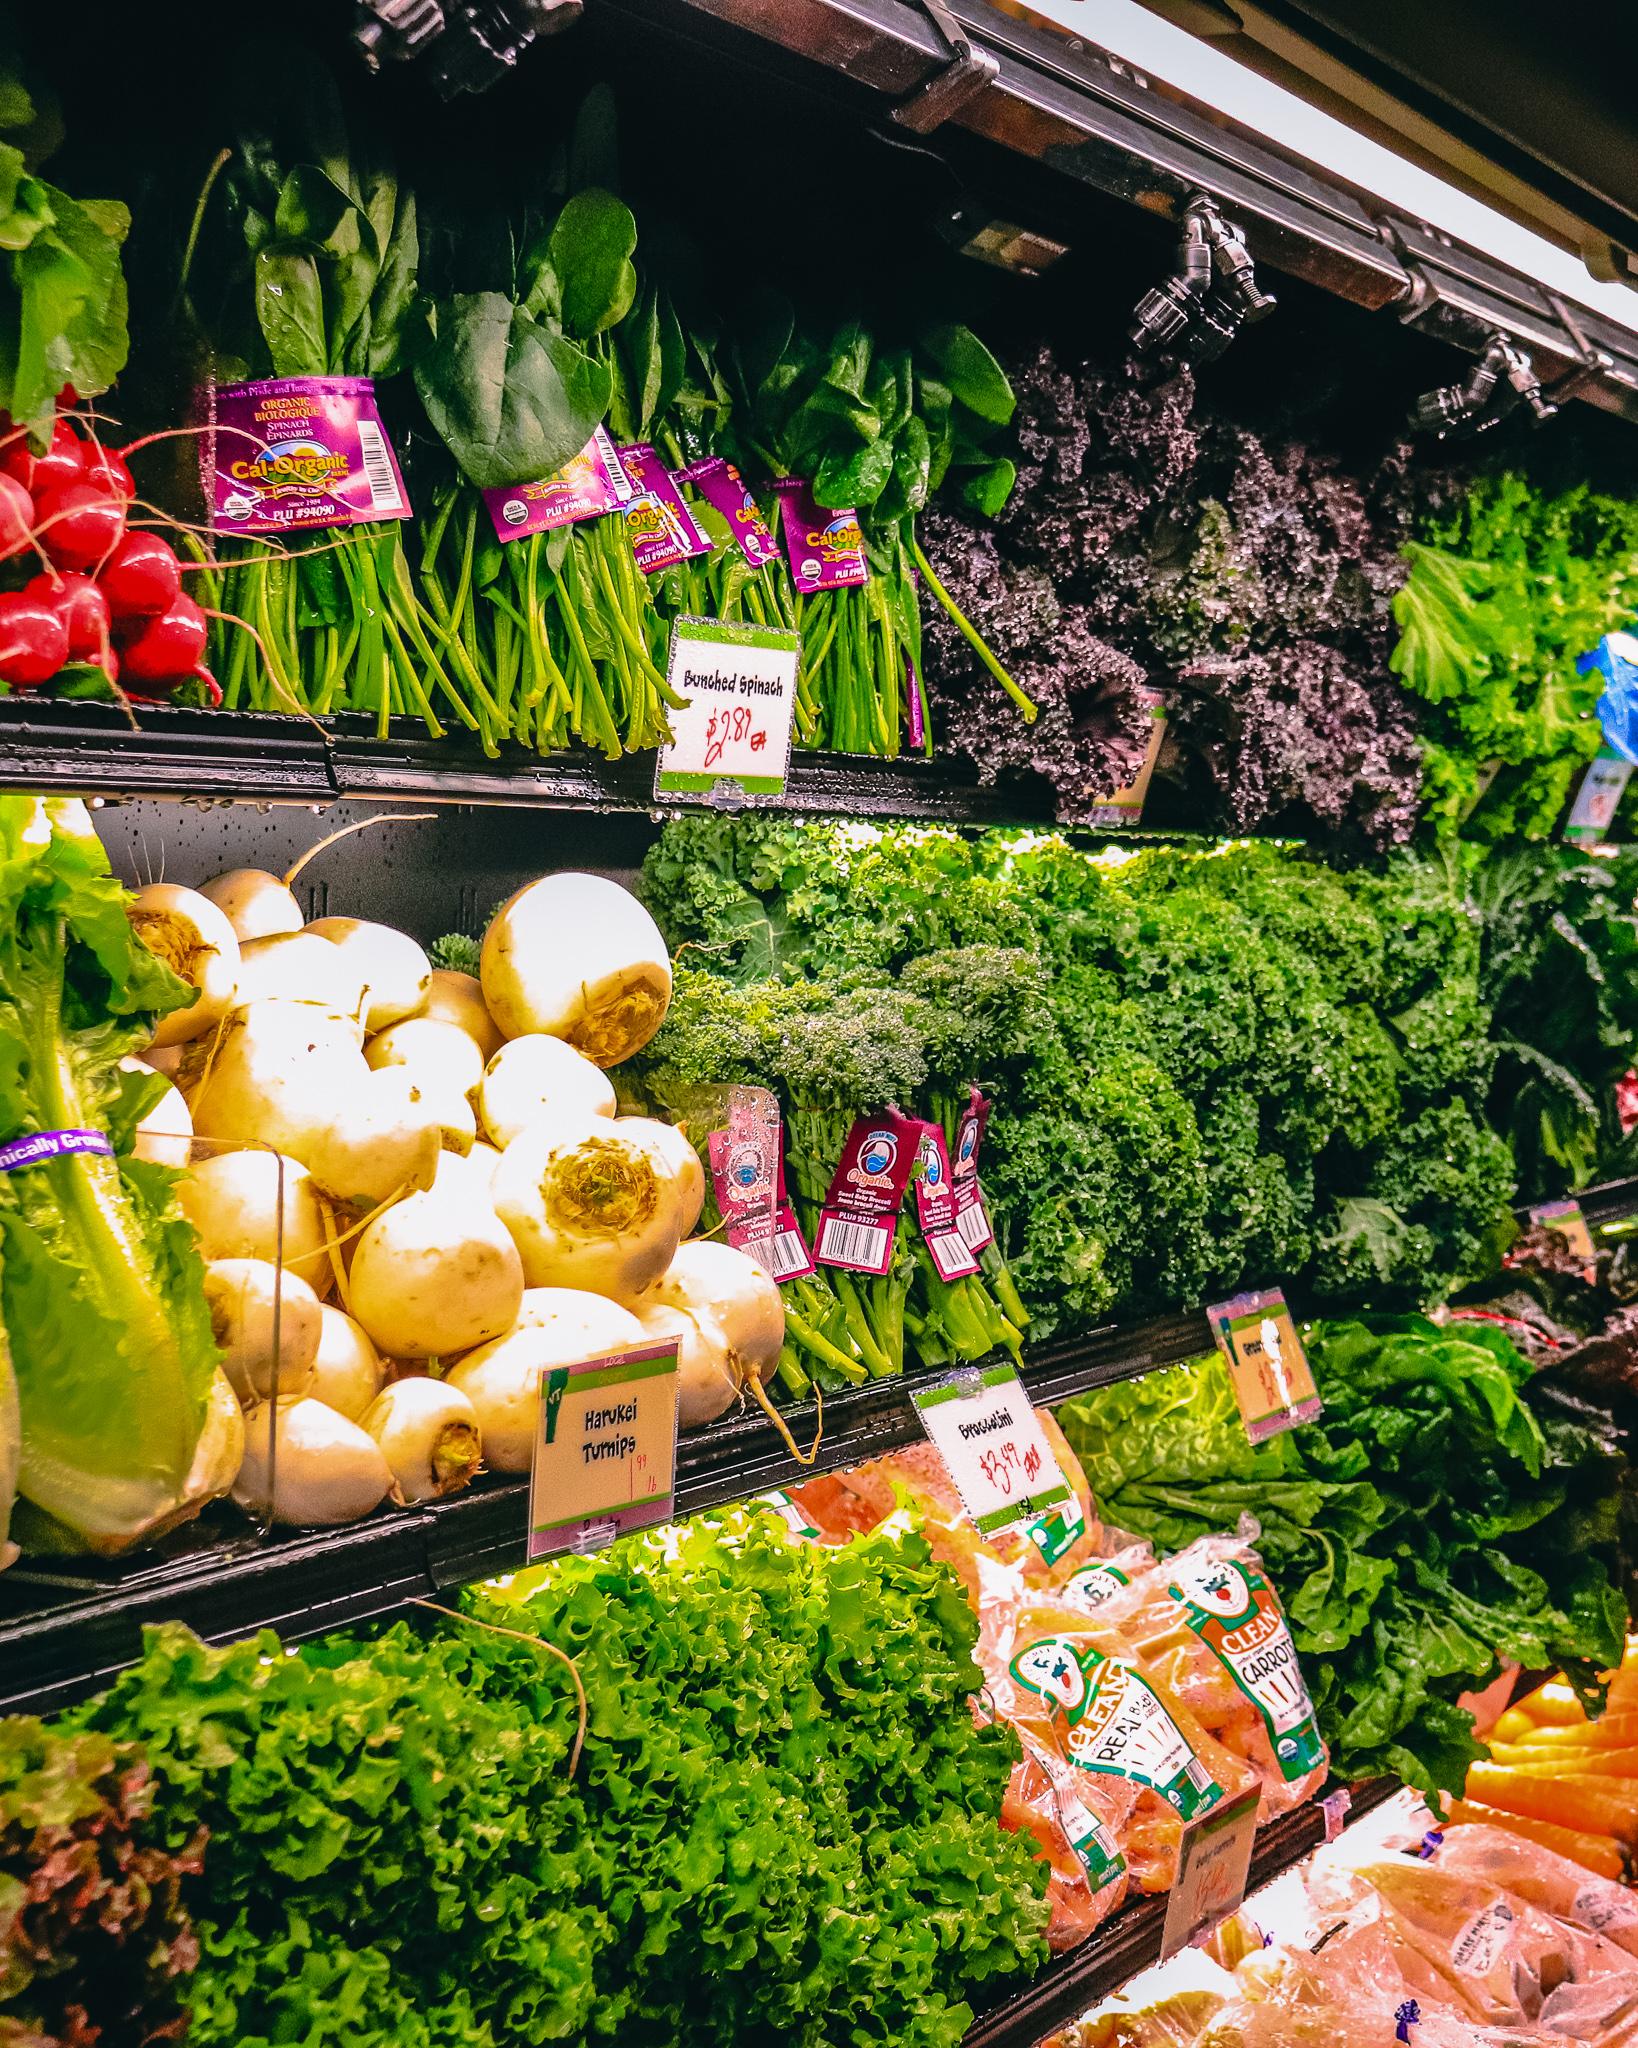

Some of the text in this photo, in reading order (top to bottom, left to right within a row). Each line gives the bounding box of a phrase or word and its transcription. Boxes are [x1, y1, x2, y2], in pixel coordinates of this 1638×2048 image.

[260, 397, 311, 410] ORGANIC
[254, 408, 319, 422] BIOLOGIQUE
[267, 420, 310, 431] SPINACH
[231, 452, 349, 480] Cal-Organic
[273, 509, 293, 521] PLU
[296, 504, 335, 519] #94090
[546, 505, 563, 518] PLU
[637, 554, 652, 566] PLU
[651, 544, 678, 561] #94090
[683, 669, 784, 698] Bunched Spinach
[857, 1214, 879, 1226] 93277
[548, 1387, 561, 1404] VT
[585, 1397, 637, 1431] Harukei
[958, 1407, 1014, 1440] Broccolini
[582, 1432, 636, 1464] Turnips
[1221, 1605, 1281, 1653] CLEAN
[1067, 1664, 1128, 1751] CLEAN
